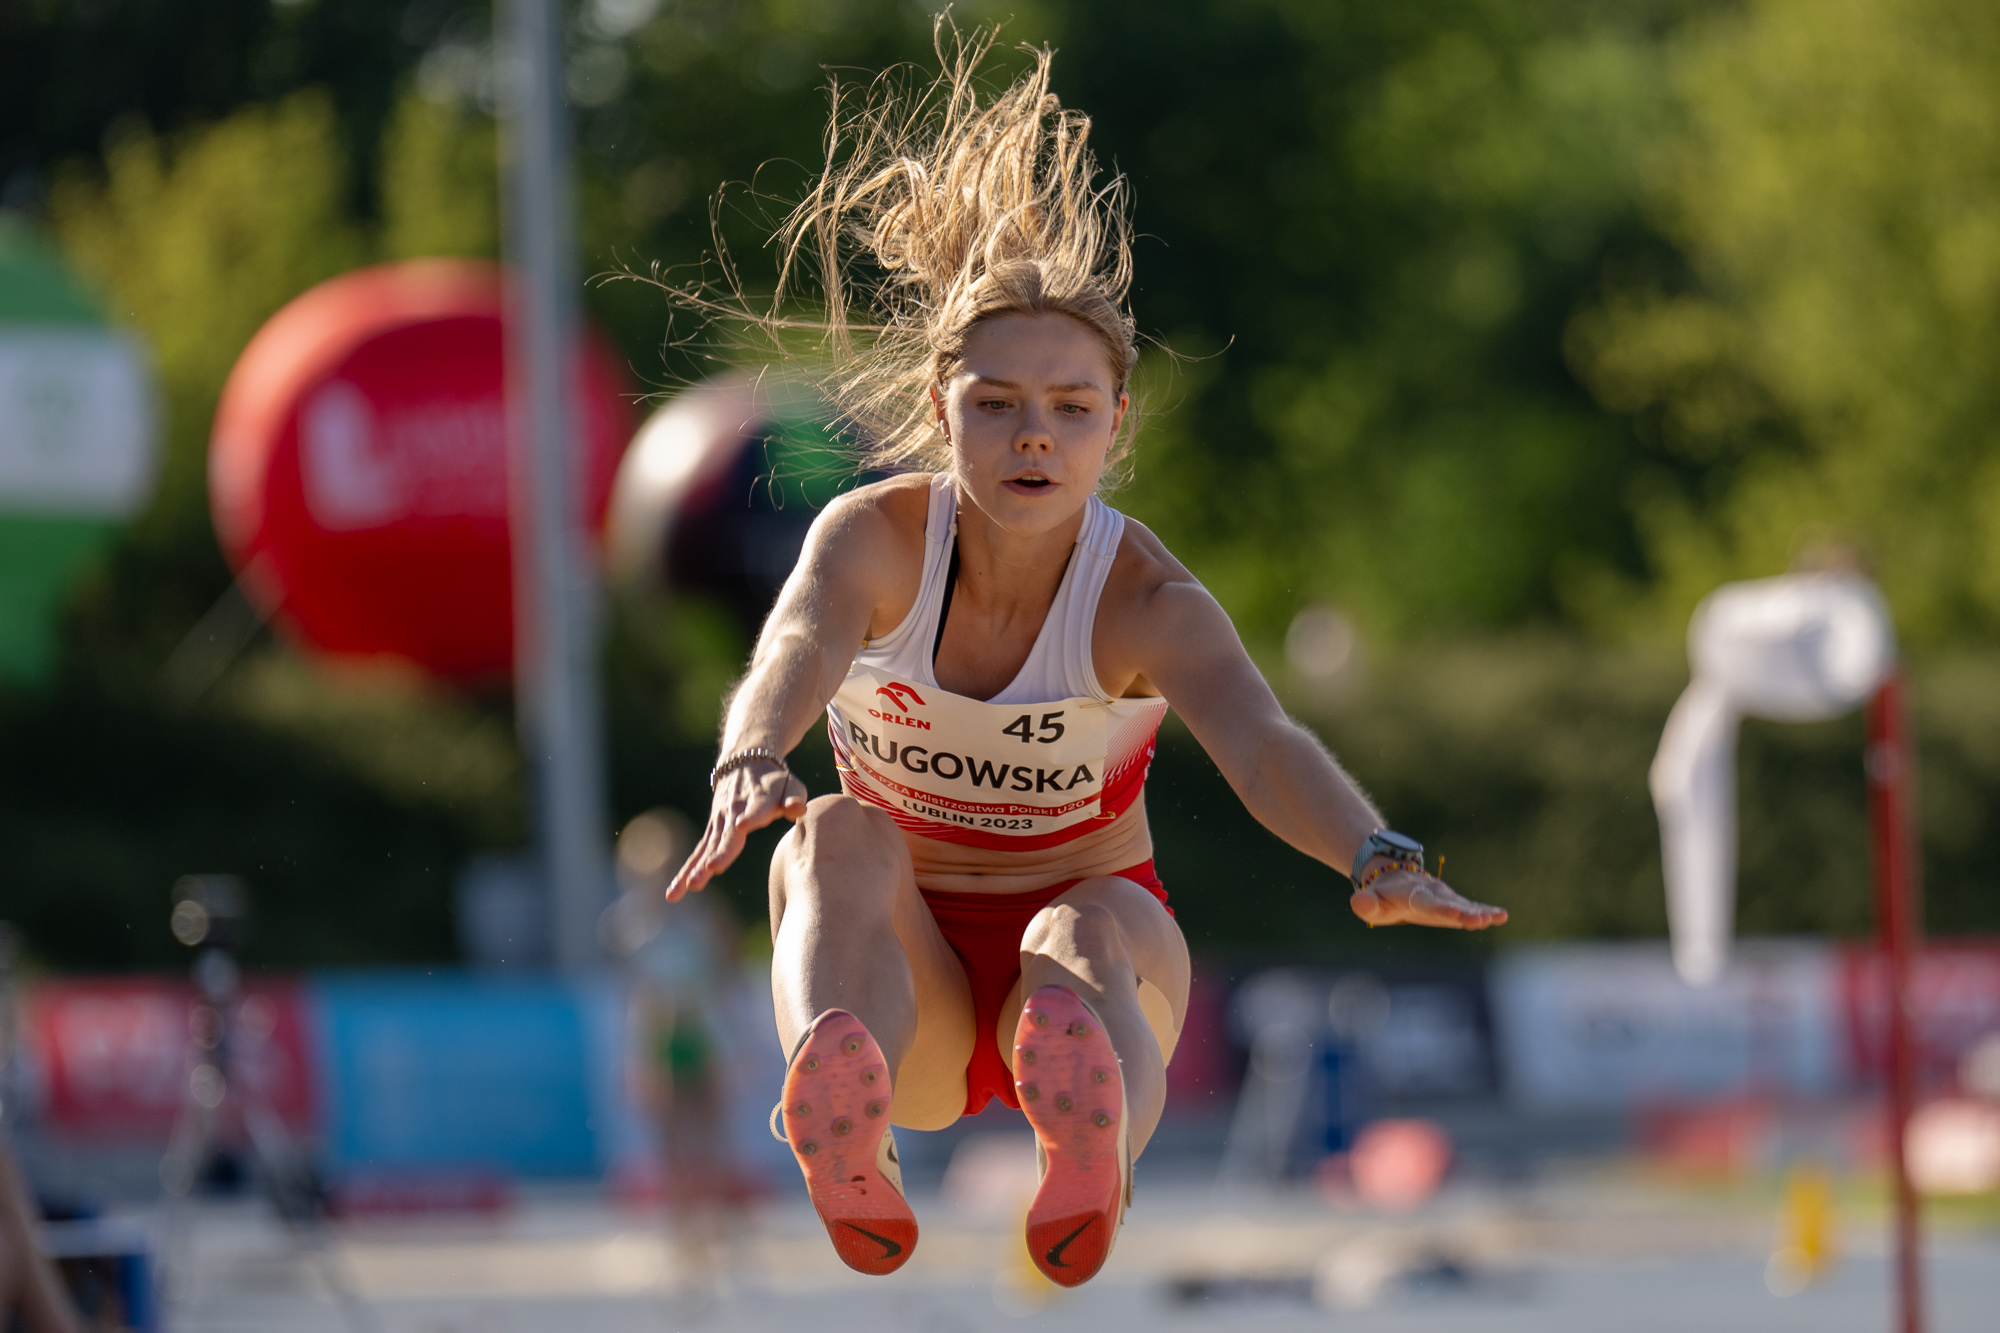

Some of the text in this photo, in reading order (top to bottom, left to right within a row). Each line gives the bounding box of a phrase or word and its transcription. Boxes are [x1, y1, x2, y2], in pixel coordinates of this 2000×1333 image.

[867, 708, 931, 731] ORLEN
[1001, 710, 1065, 744] 45
[848, 719, 1095, 794] RUGOWSKA
[878, 776, 911, 796] PZLA
[914, 791, 1005, 814] Mistrzostwa
[1009, 805, 1053, 816] Polski
[1057, 800, 1085, 814] U20
[902, 799, 1033, 830] LUBLIN 2023
